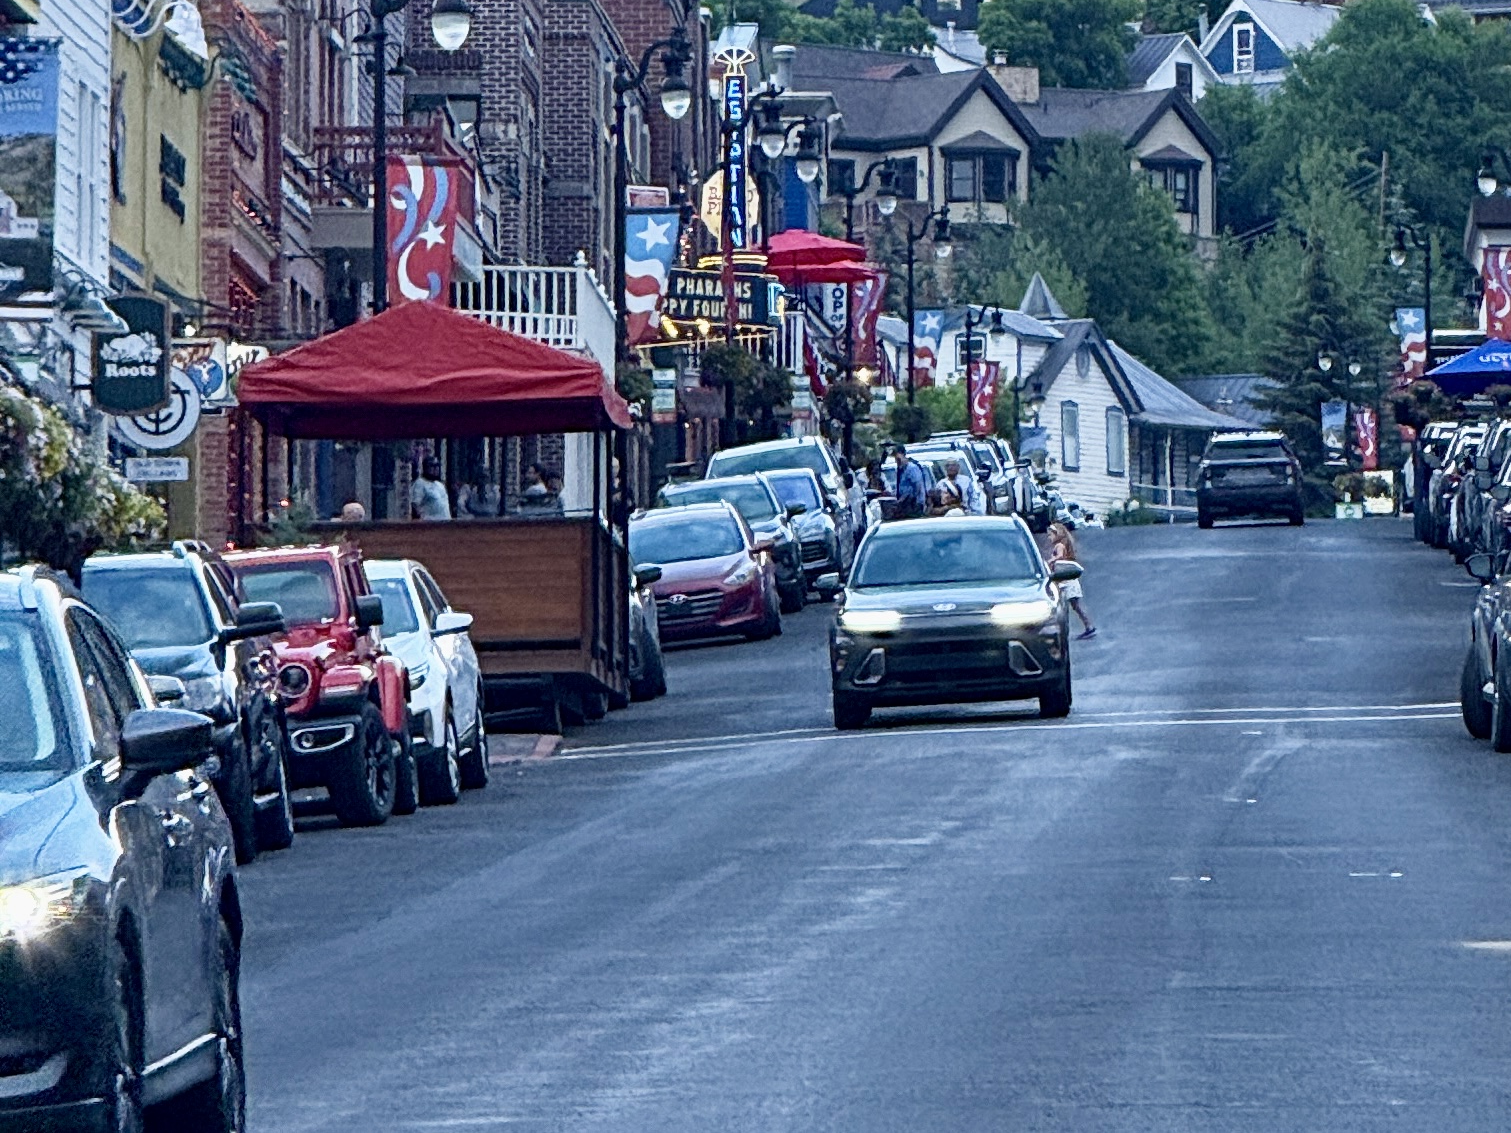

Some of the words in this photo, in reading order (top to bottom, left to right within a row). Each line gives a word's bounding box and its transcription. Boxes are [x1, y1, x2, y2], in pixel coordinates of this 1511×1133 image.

[727, 79, 743, 247] EGPTIAN
[677, 277, 751, 299] PHARAHS
[105, 364, 156, 377] Roots
